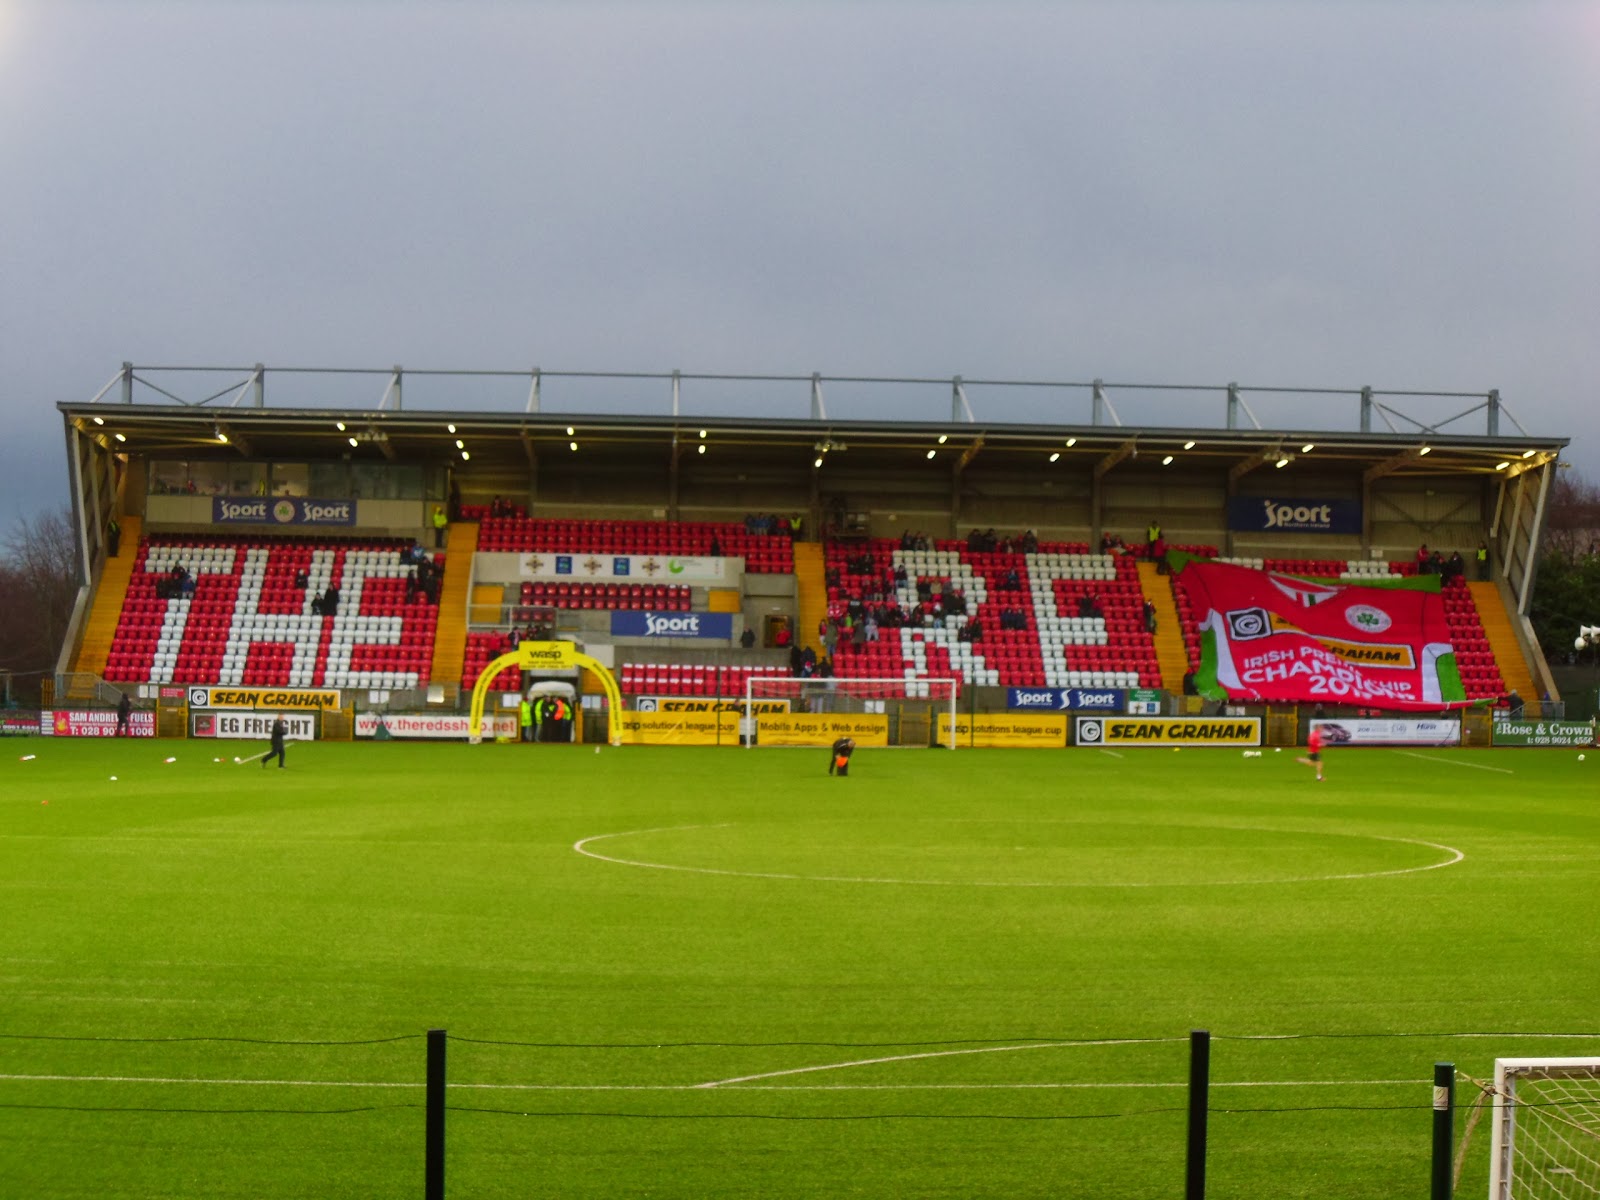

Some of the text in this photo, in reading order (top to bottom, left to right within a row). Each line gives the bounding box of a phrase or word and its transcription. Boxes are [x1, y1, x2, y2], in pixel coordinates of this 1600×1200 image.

[1244, 649, 1295, 669] IRISH
[1327, 645, 1401, 661] RAHAM
[213, 692, 260, 705] SEAN
[263, 693, 336, 706] GRAHAM
[70, 713, 154, 722] SAM ANDRE FUELS
[82, 727, 99, 736] 028
[131, 727, 154, 736] 1006
[220, 718, 311, 736] EG FREGHT
[621, 721, 641, 732] asp
[685, 722, 716, 732] league
[760, 722, 886, 734] Mobile Apps & Web design
[1013, 724, 1043, 735] league
[1045, 727, 1062, 735] cup
[1109, 724, 1164, 738] SEAN
[1168, 724, 1253, 739] GRAHAM
[1503, 723, 1532, 735] Rose
[1536, 723, 1546, 735] &
[1549, 723, 1593, 735] Crown
